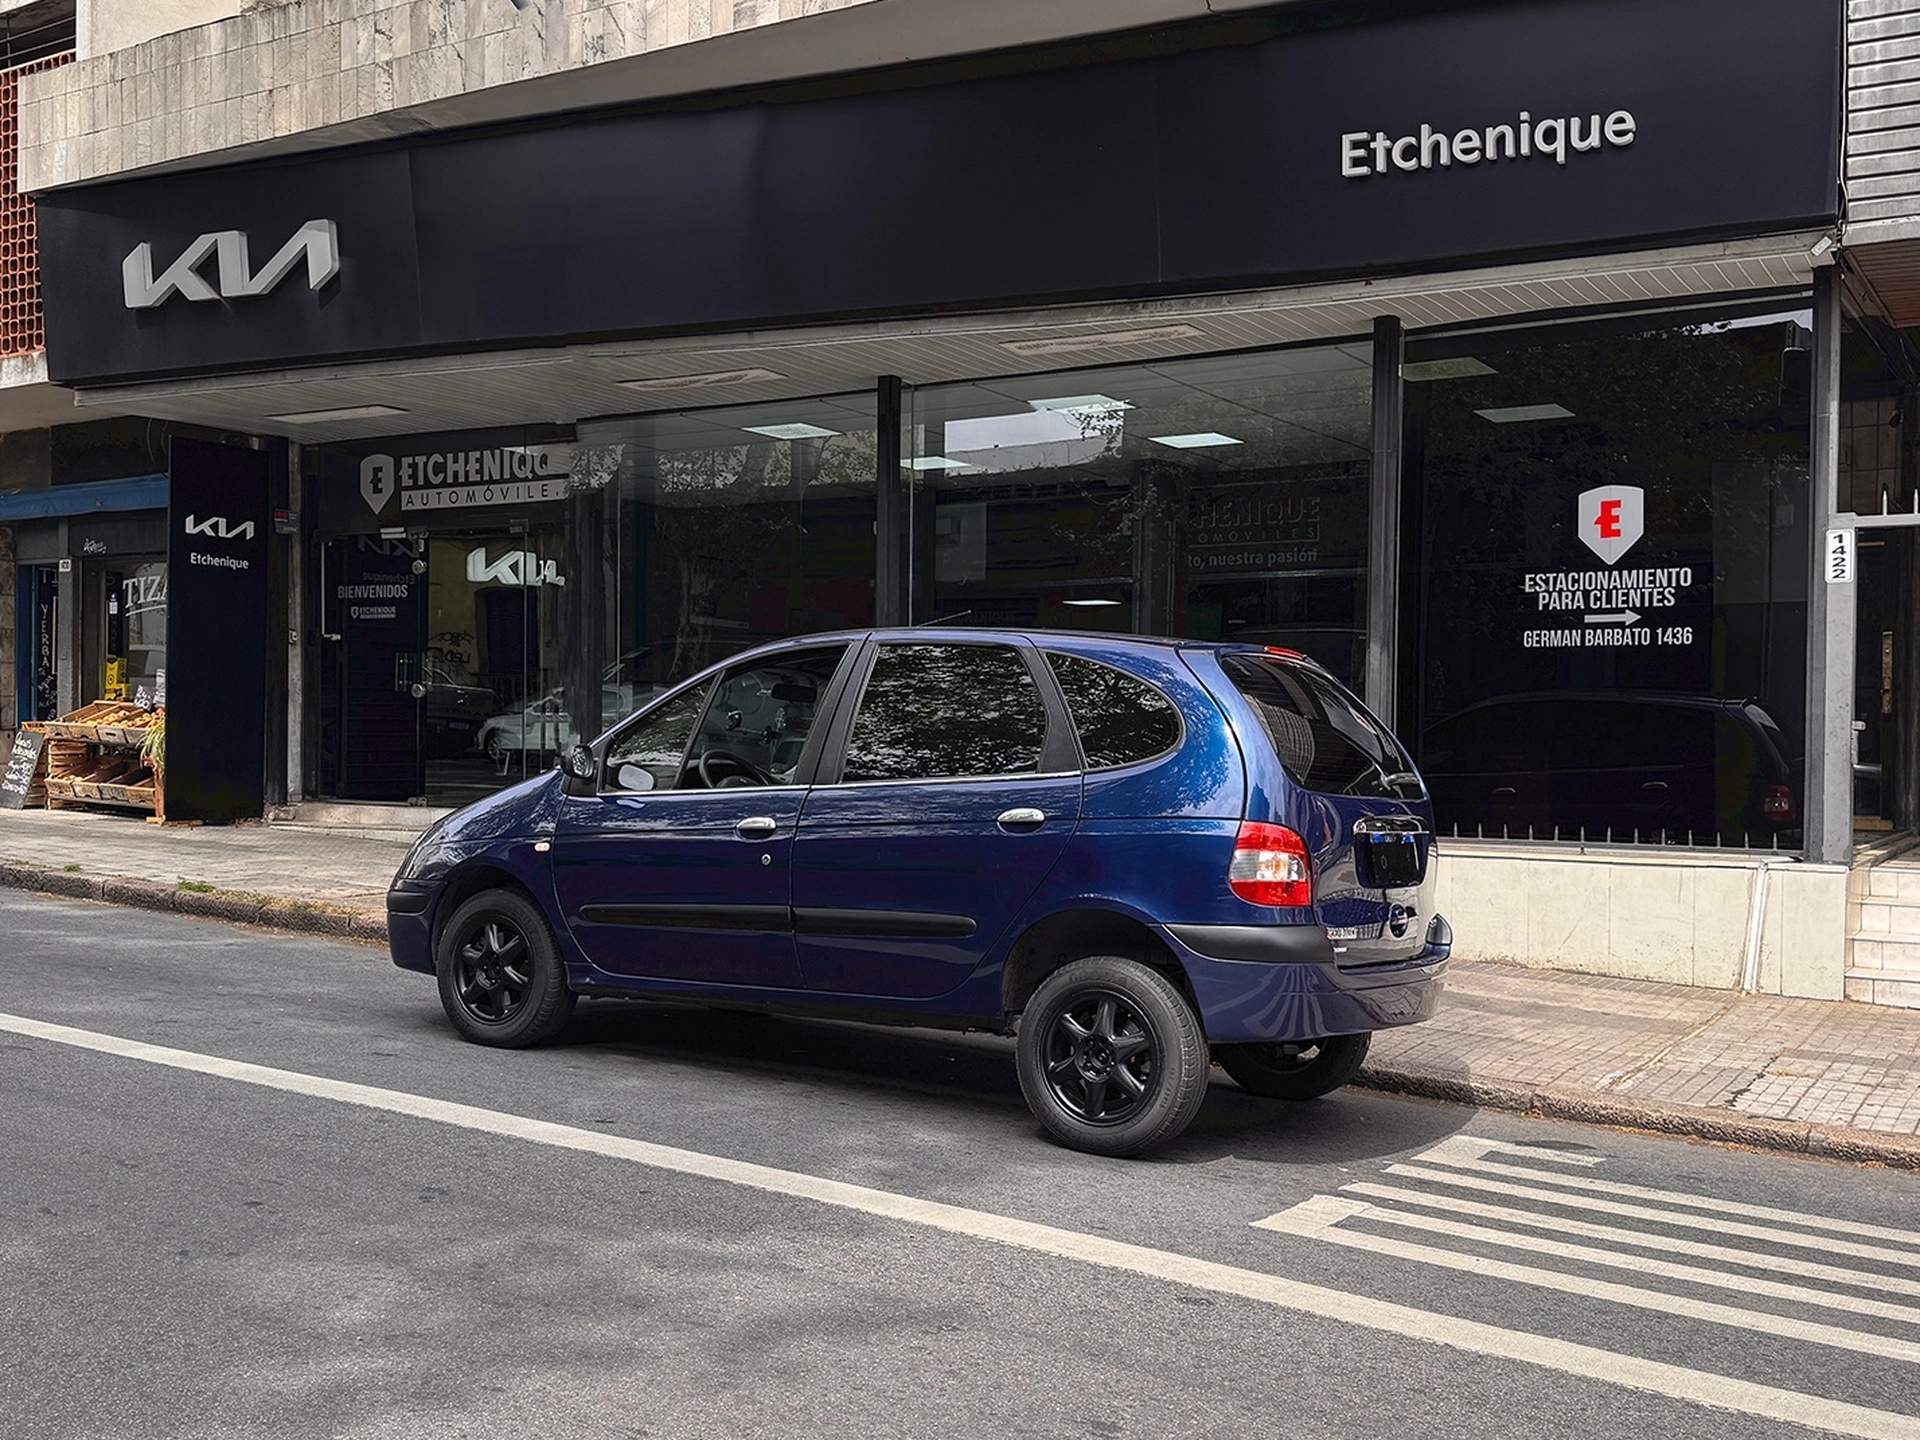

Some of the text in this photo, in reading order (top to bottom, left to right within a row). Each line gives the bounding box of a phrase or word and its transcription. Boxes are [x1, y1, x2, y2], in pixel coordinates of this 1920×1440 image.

[1341, 109, 1637, 178] Etchenique
[122, 218, 340, 309] KIA
[405, 483, 561, 508] AUTOMÓVILE
[185, 513, 255, 541] KIA
[190, 552, 250, 571] Etchenique
[1209, 551, 1264, 567] nuestra
[1267, 547, 1318, 567] pasión
[1832, 533, 1848, 580] 1422
[337, 584, 409, 599] BIENVENIDOS
[1524, 567, 1692, 593] ESTACIONAMIENTO
[1538, 587, 1676, 611] PARA CLIENTES
[1523, 626, 1693, 648] GERMAN BARBATO 1436
